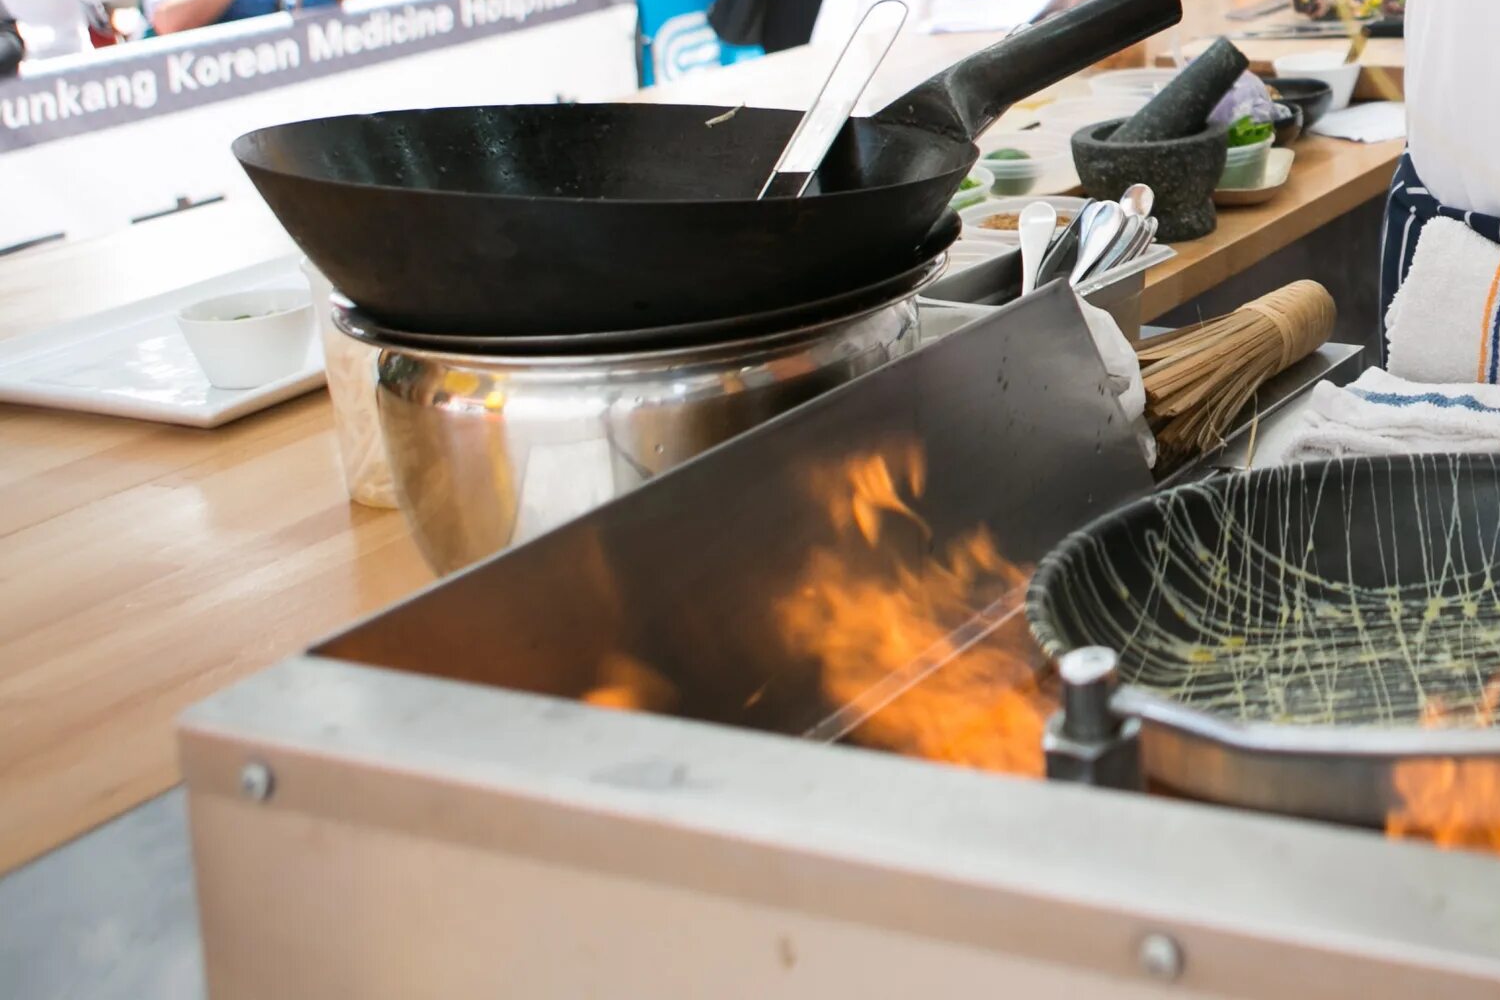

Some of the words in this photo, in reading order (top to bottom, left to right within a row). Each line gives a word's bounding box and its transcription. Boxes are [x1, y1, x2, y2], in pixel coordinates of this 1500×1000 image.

[0, 68, 157, 131] unkang
[165, 36, 300, 95] Korean
[307, 2, 455, 64] Medicine
